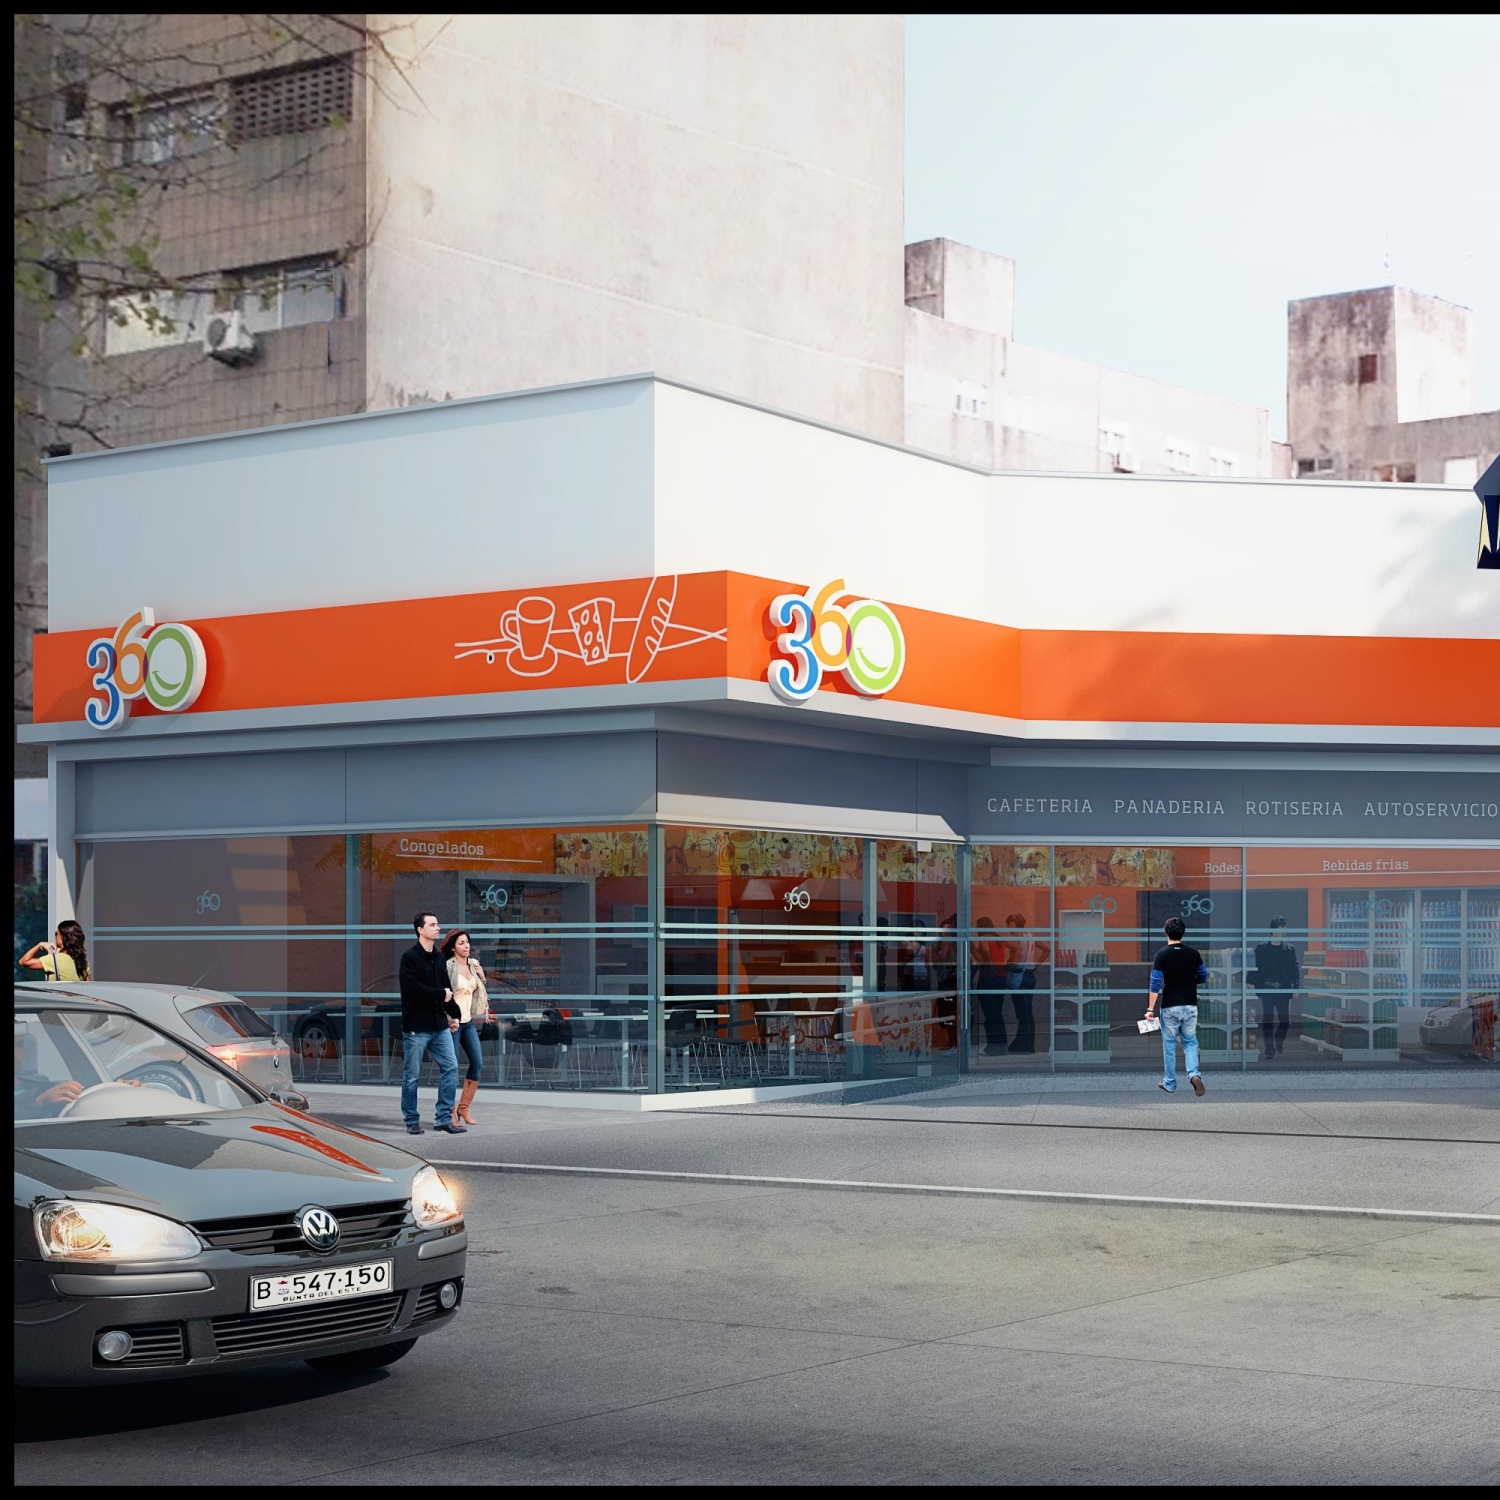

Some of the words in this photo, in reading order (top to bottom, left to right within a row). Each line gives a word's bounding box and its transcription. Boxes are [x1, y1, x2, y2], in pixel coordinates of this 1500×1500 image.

[772, 577, 904, 699] 360
[86, 608, 199, 728] 360
[987, 798, 1093, 813] CAFETERIA
[1114, 799, 1225, 815] PANADERIA
[1245, 800, 1344, 816] ROTISERIA
[1363, 802, 1499, 818] AUTOSERVICIO
[400, 838, 484, 856] Congelados
[1322, 860, 1373, 871] Bebidas
[196, 889, 221, 915] 360
[480, 884, 508, 911] 360
[784, 886, 811, 912] 360
[1083, 894, 1118, 917] 360
[1181, 894, 1214, 917] 360
[257, 1281, 271, 1300] B
[283, 1294, 315, 1302] PUNTA
[318, 1289, 335, 1298] DEL
[338, 1286, 361, 1294] ESTE
